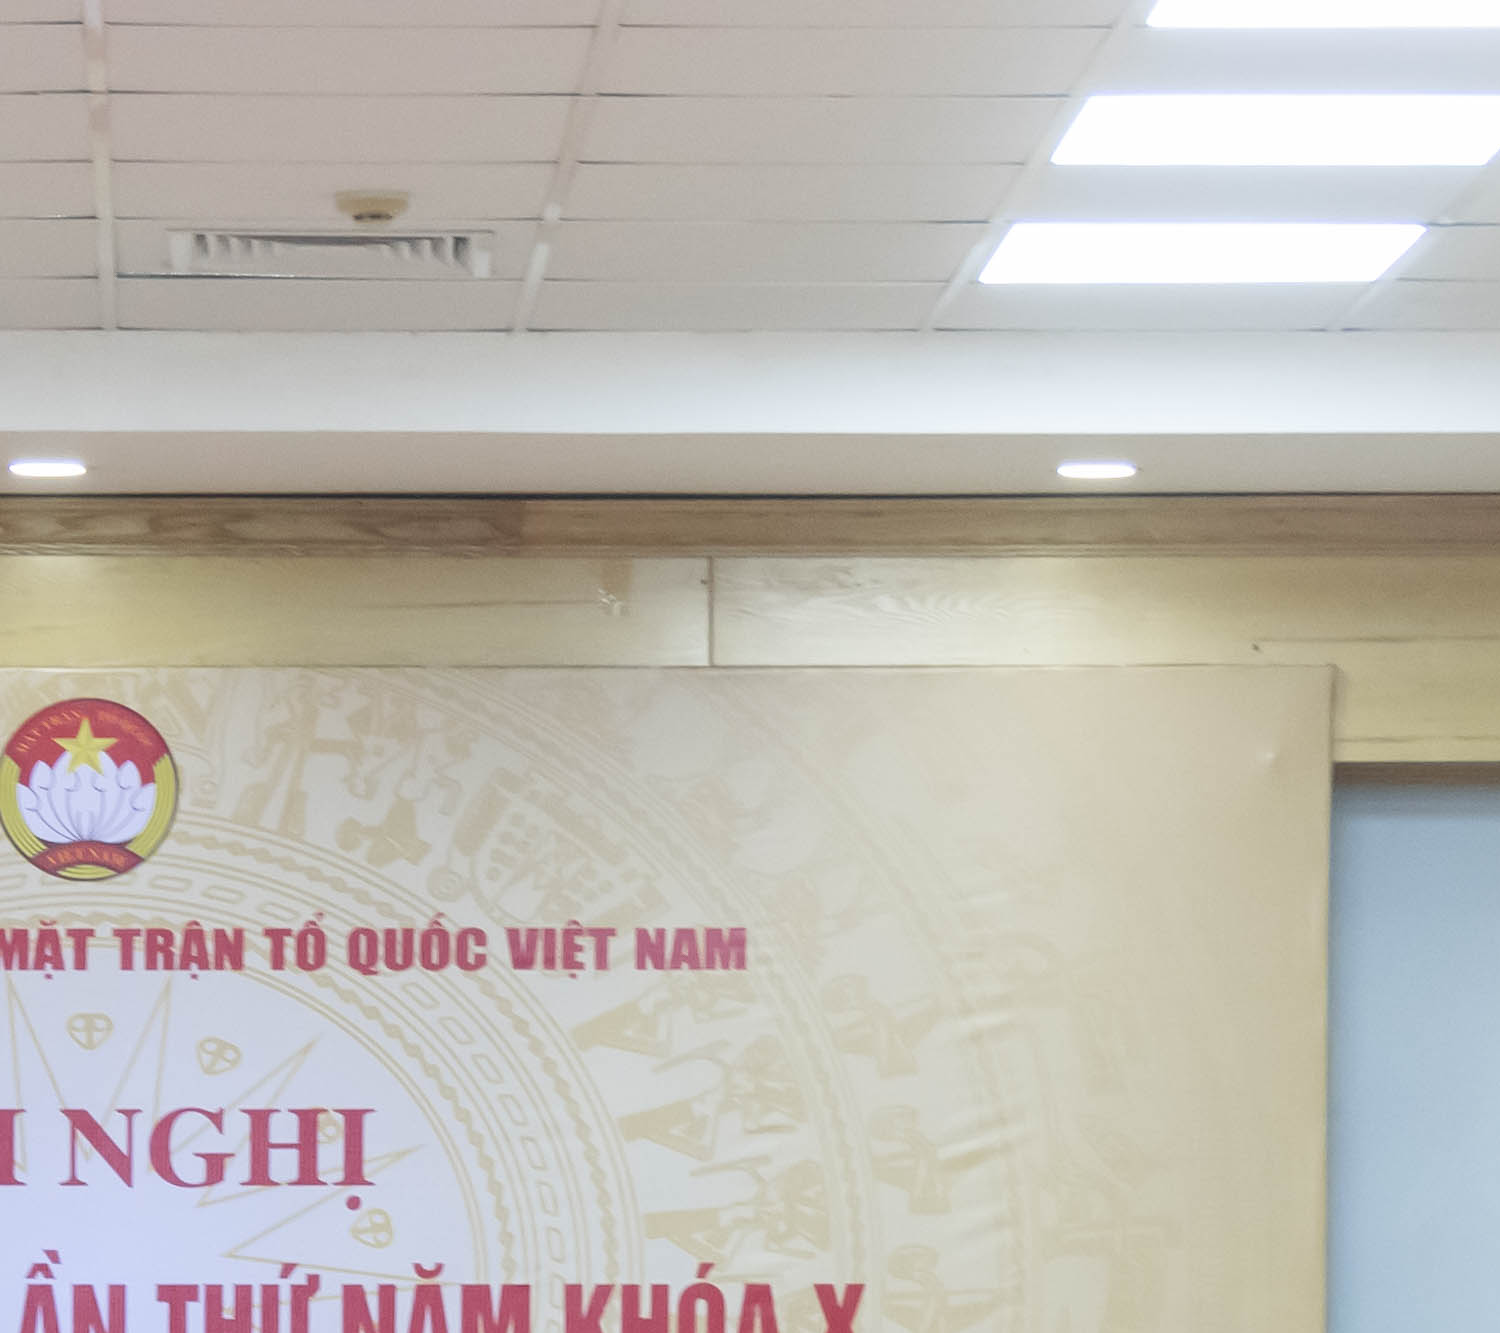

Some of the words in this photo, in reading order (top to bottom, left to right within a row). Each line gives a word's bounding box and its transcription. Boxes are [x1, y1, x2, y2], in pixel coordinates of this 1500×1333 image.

[112, 920, 245, 980] TRẬN
[262, 912, 328, 972] TỔ
[346, 912, 488, 976] QUỐC
[506, 921, 618, 979] VIỆT
[635, 926, 748, 971] NAM
[59, 1106, 376, 1211] NGHỊ
